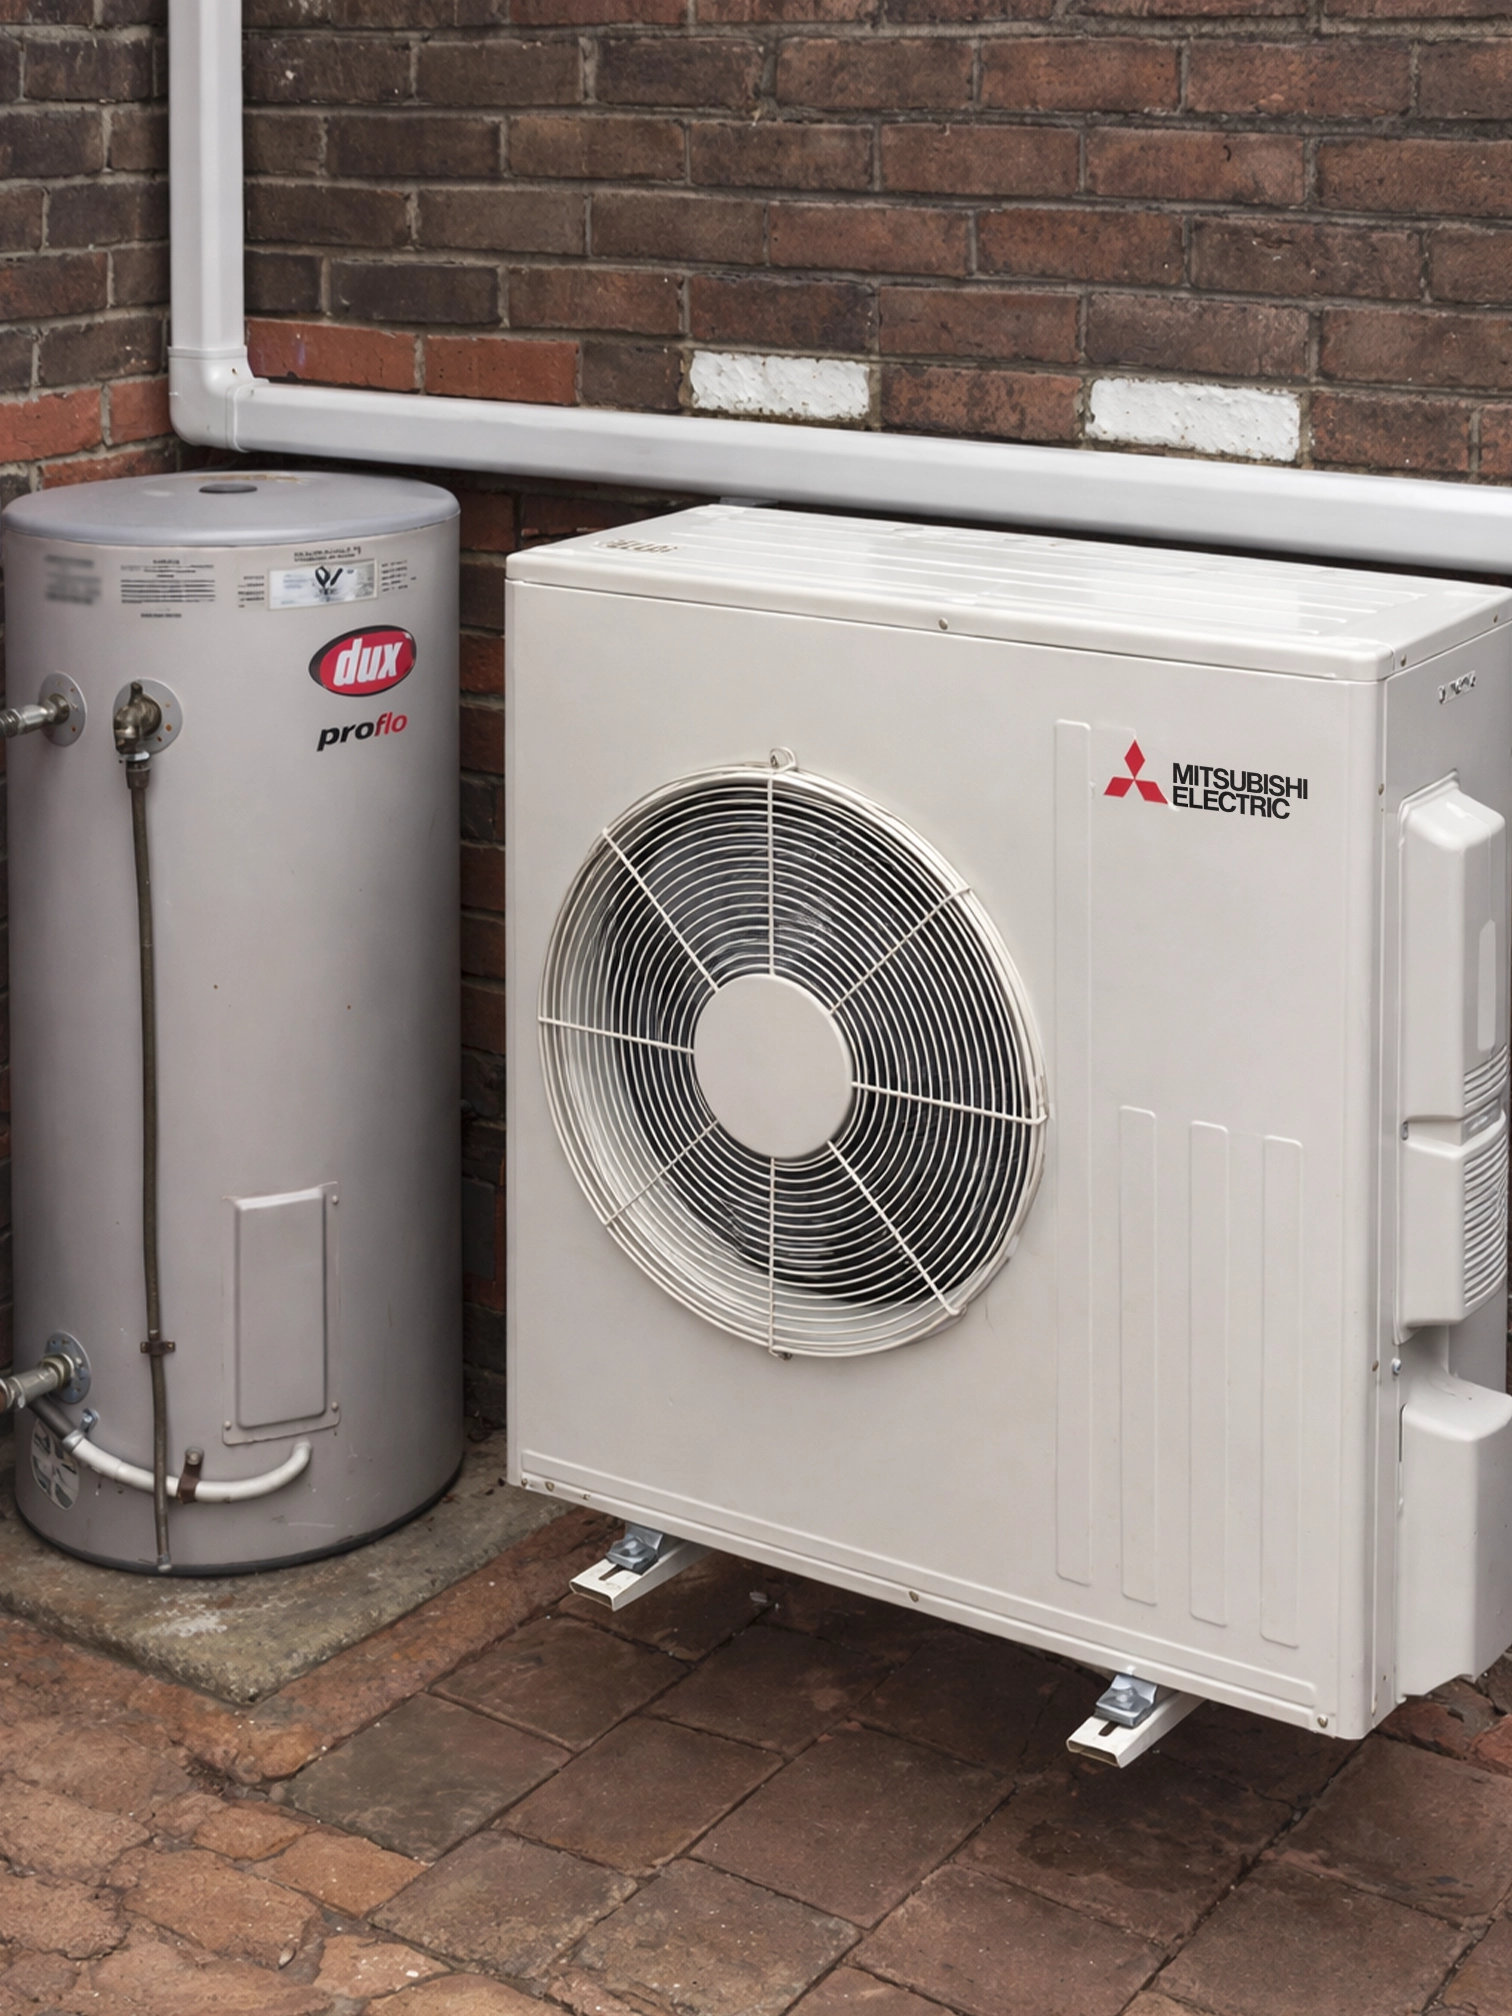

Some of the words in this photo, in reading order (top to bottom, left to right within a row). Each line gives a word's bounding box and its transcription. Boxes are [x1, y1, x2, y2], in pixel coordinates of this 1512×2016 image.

[333, 637, 403, 687] dux
[316, 711, 408, 752] proflo
[1172, 762, 1308, 799] MITSUBISHI
[1172, 785, 1291, 819] ELECTRIC
